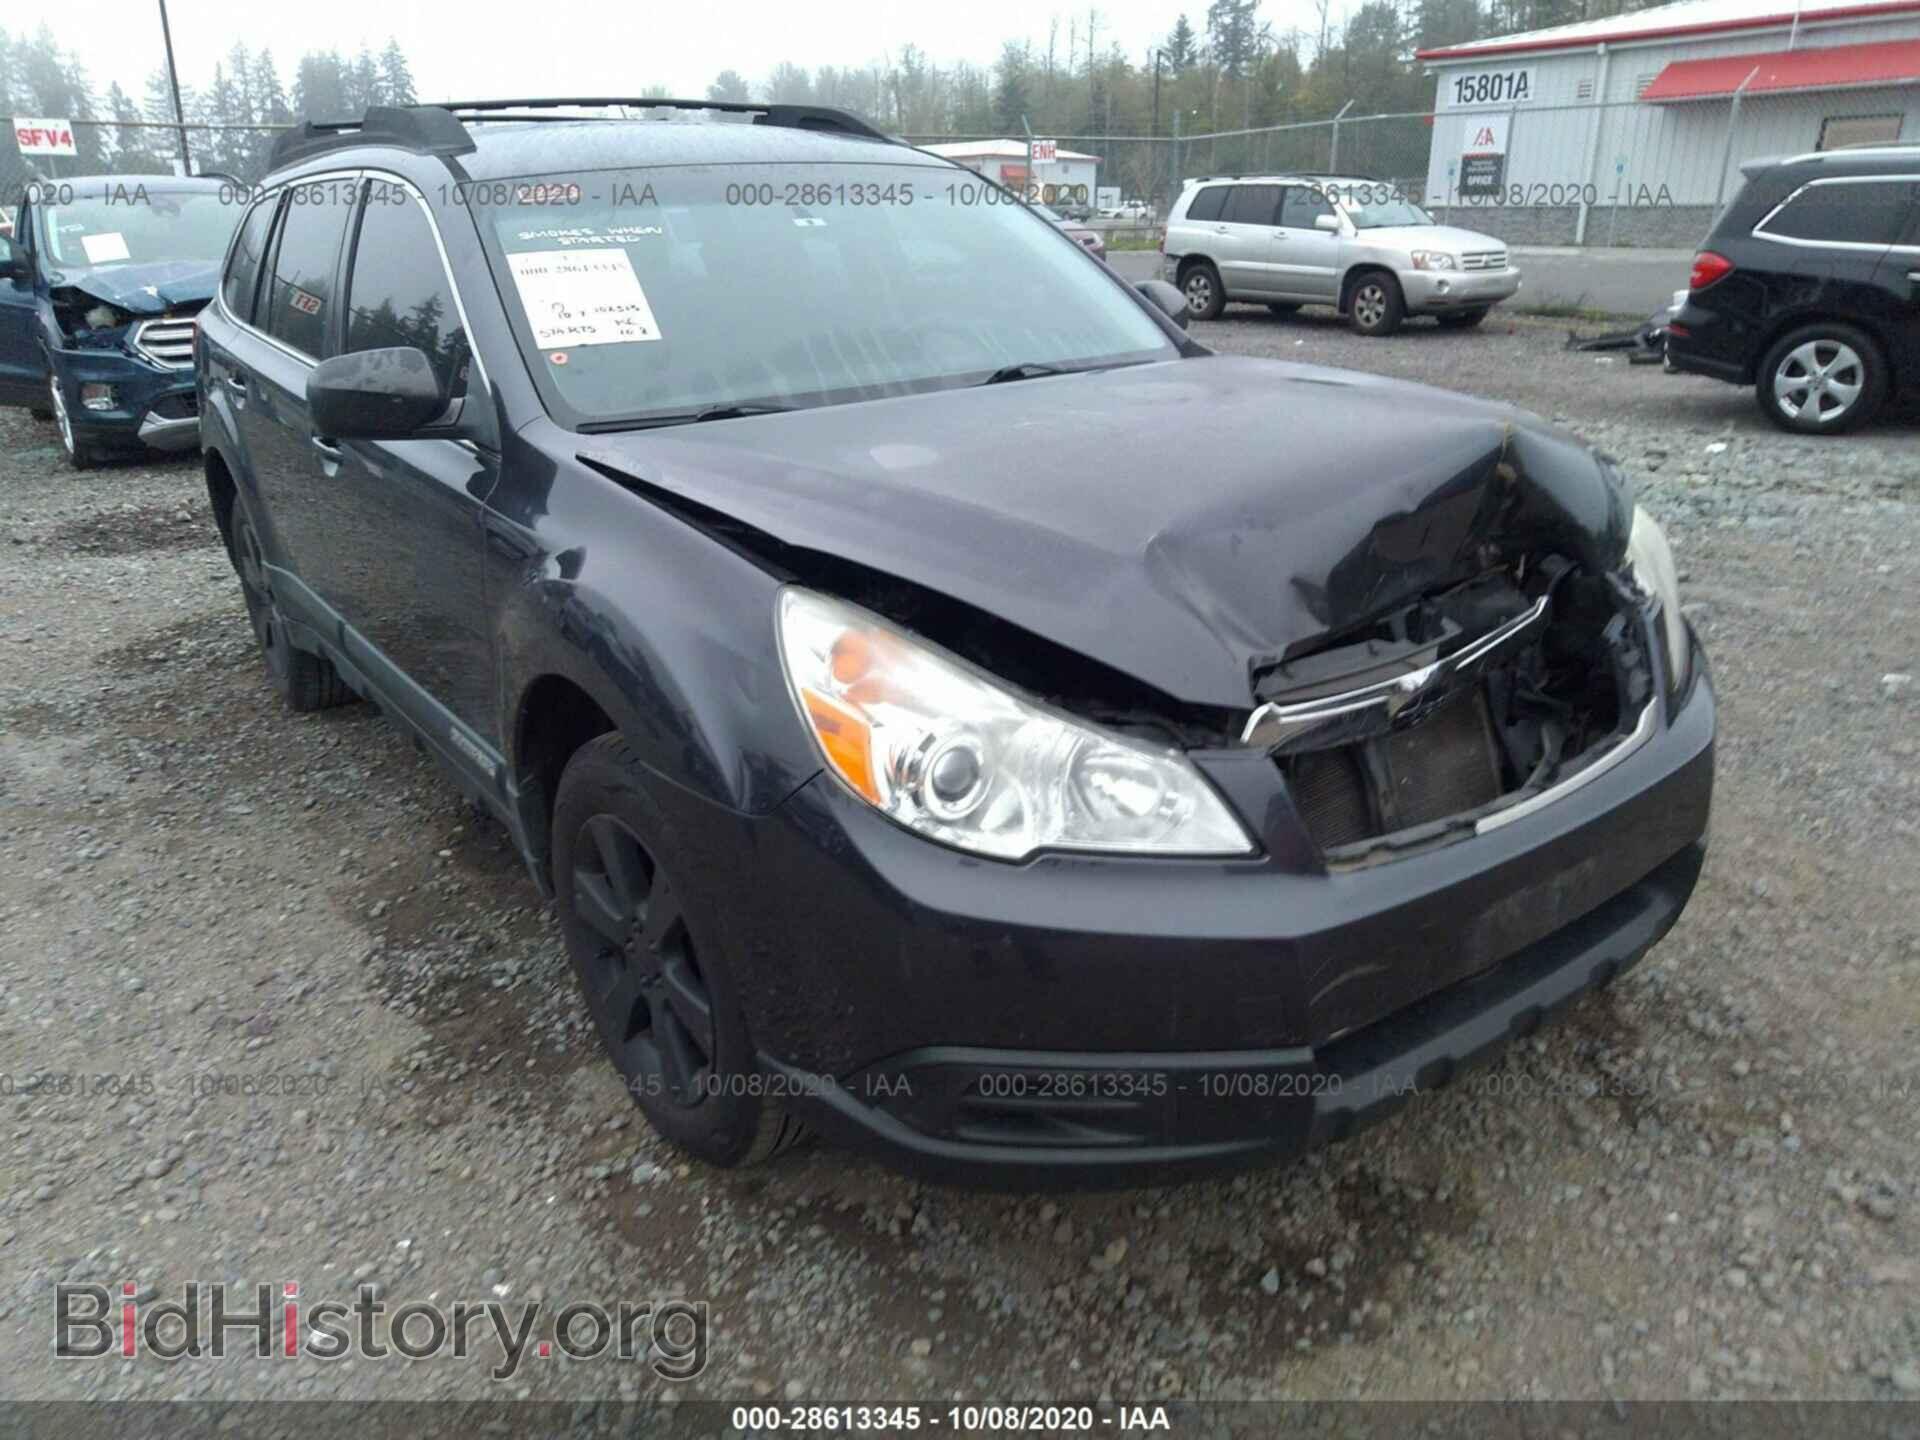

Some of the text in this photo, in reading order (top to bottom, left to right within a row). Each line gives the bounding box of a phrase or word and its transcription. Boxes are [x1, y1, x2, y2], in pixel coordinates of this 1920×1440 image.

[1454, 71, 1529, 103] 15801A
[16, 128, 73, 147] SFV4
[1031, 143, 1056, 160] ENH
